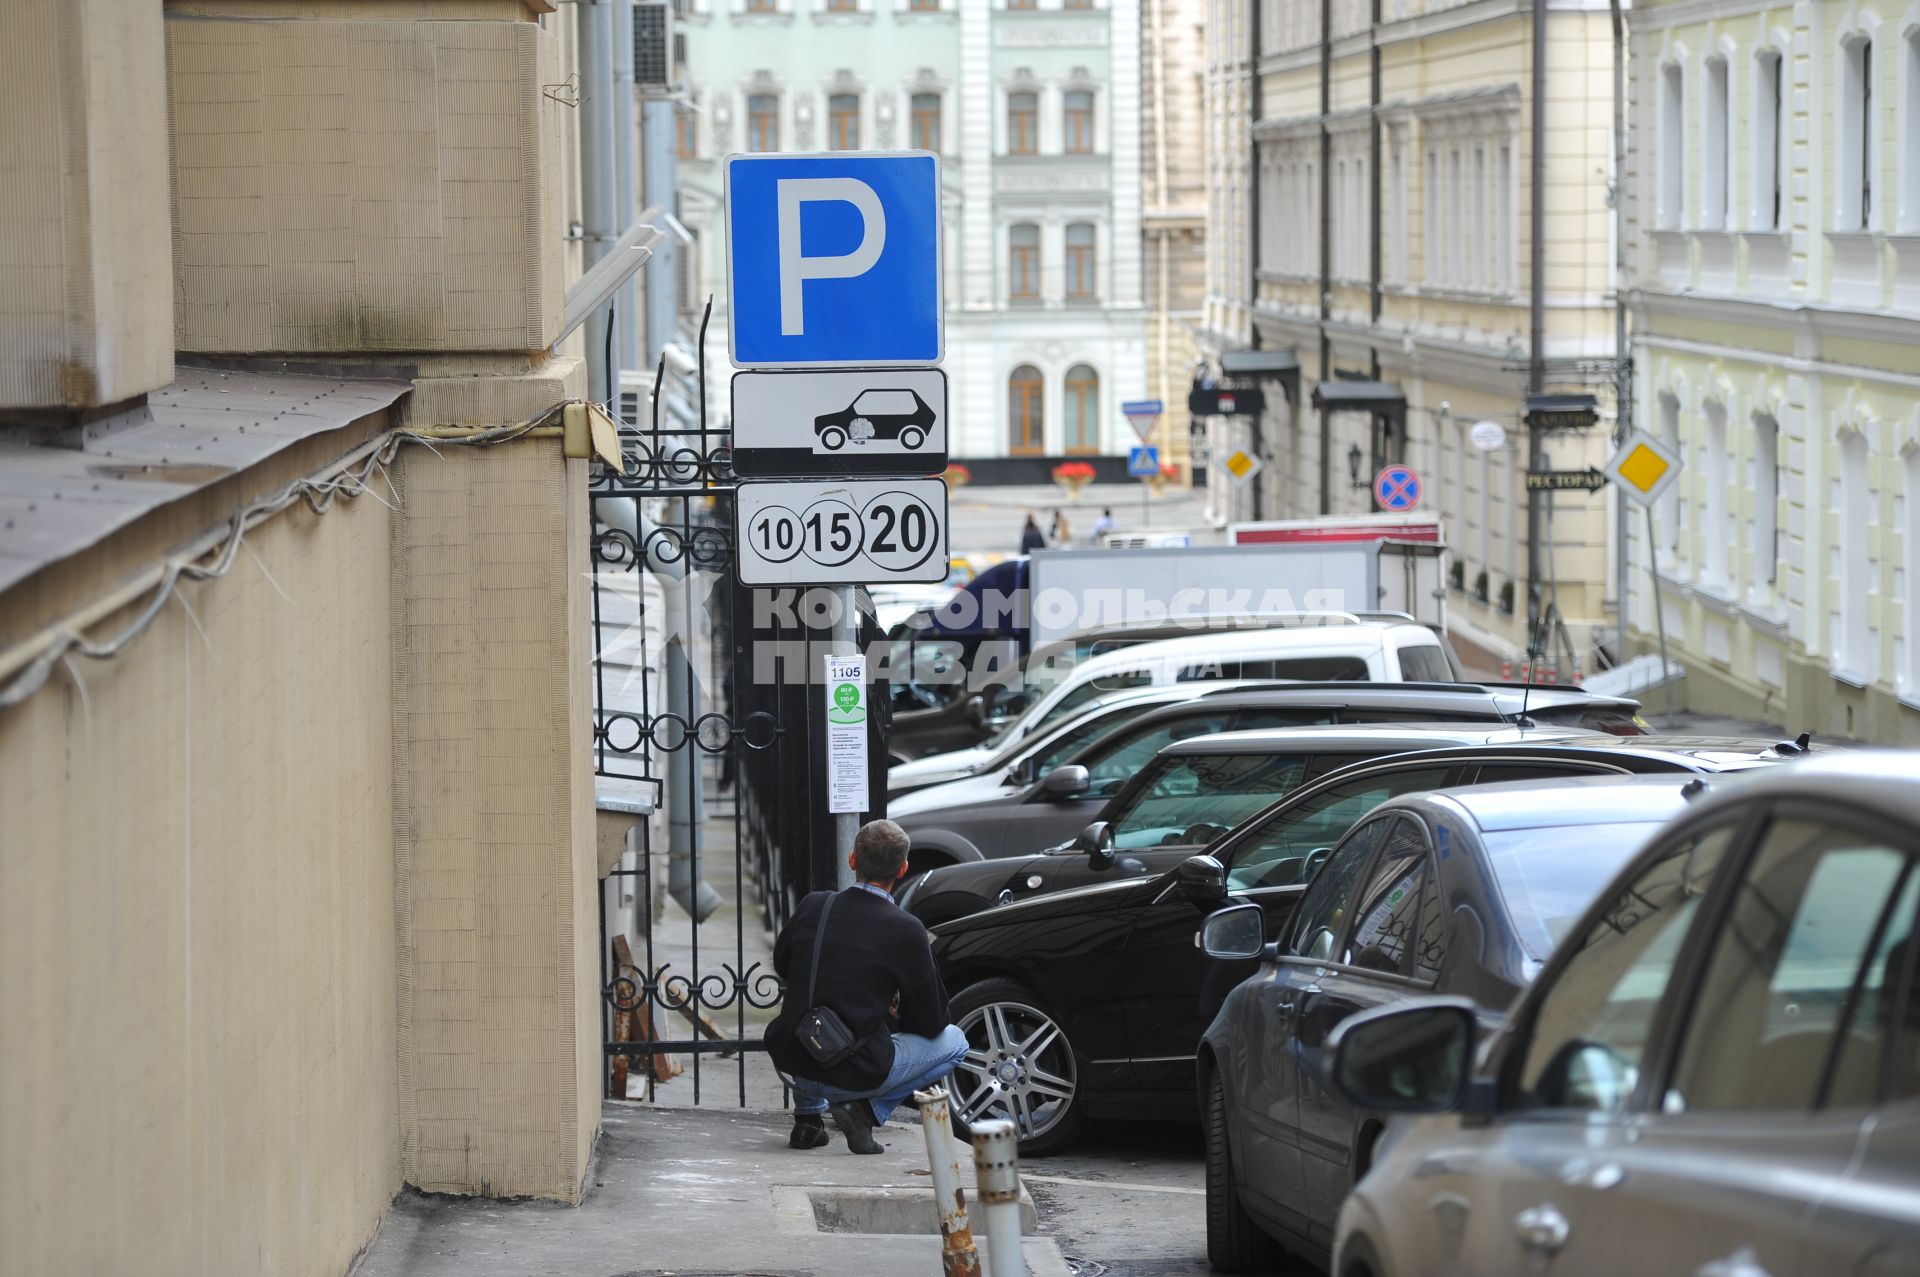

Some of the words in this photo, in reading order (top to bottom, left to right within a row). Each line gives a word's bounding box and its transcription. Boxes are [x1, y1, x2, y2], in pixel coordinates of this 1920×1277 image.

[777, 177, 887, 336] P
[1527, 474, 1605, 489] РЕСТОРАН
[757, 518, 794, 551] 10
[806, 512, 852, 553] 15
[870, 504, 927, 554] 20
[831, 667, 861, 678] 1105
